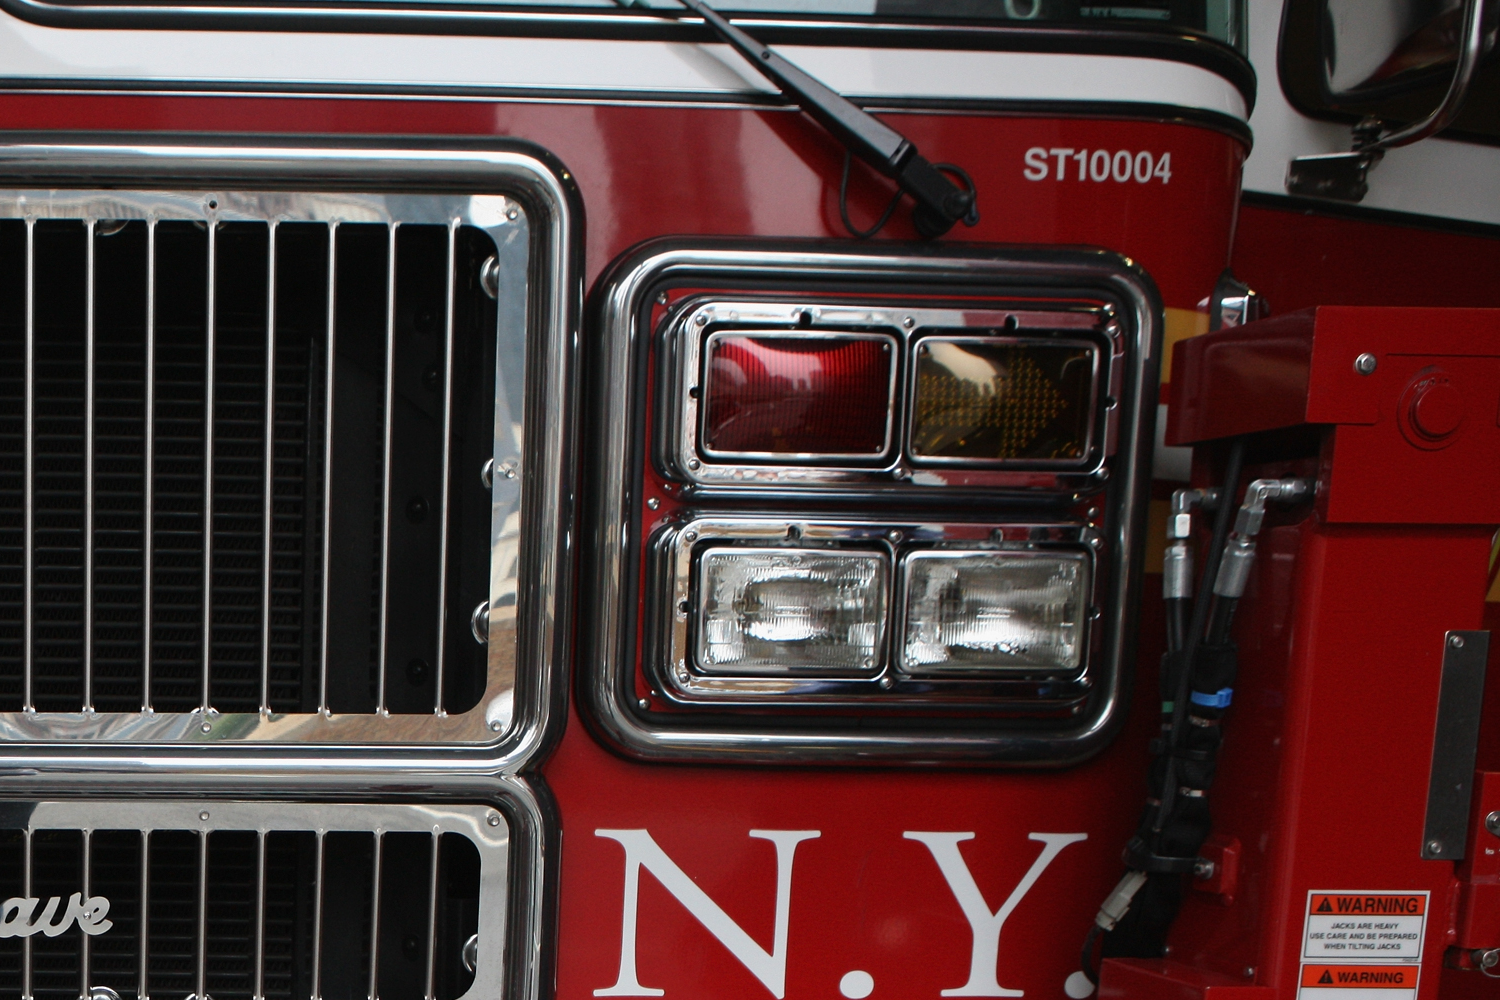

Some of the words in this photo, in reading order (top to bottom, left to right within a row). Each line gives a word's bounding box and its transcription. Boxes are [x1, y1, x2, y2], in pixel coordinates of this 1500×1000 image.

[1023, 147, 1172, 184] ST10004
[593, 829, 1096, 1000] N.Y.
[1337, 897, 1418, 913] WARNING
[1338, 972, 1404, 983] WARNING
